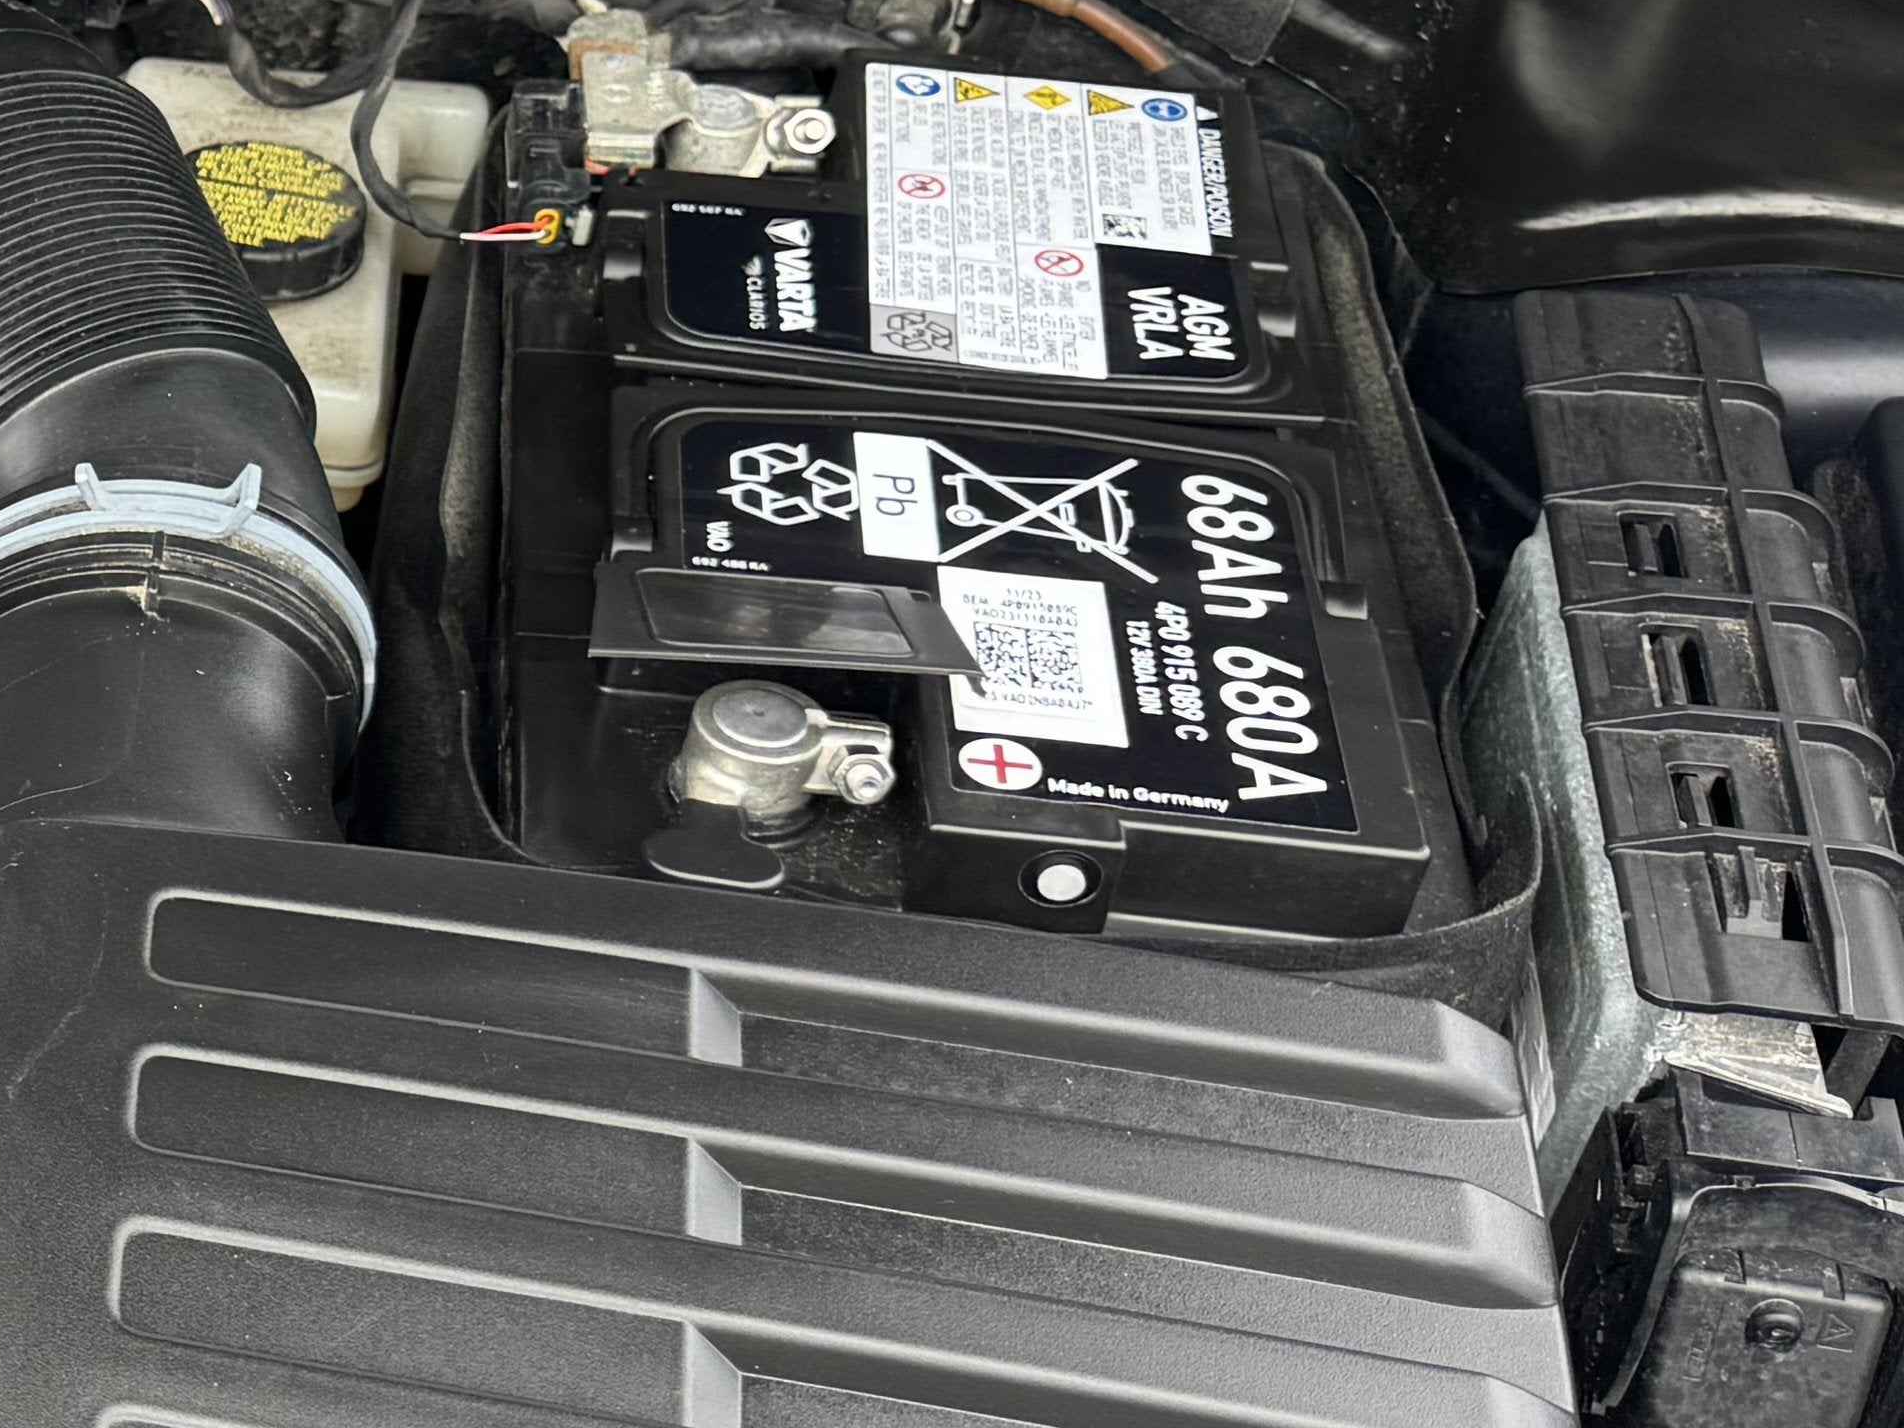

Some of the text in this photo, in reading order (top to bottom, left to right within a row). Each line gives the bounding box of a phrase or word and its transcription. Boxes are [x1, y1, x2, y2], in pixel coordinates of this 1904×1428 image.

[1199, 128, 1233, 237] DANGER/POISON
[746, 277, 769, 331] CLARIOS
[773, 248, 816, 332] VARTA
[1128, 286, 1183, 359] VRLA
[1177, 294, 1235, 360] AGM
[873, 473, 918, 517] Pb
[1161, 645, 1198, 682] 915
[1180, 474, 1327, 800] 68Ah 680A
[1126, 621, 1164, 716] 12V 380A DIN
[1167, 684, 1205, 722] 089
[1175, 725, 1209, 742] C
[1047, 778, 1229, 814] Made in Germany
